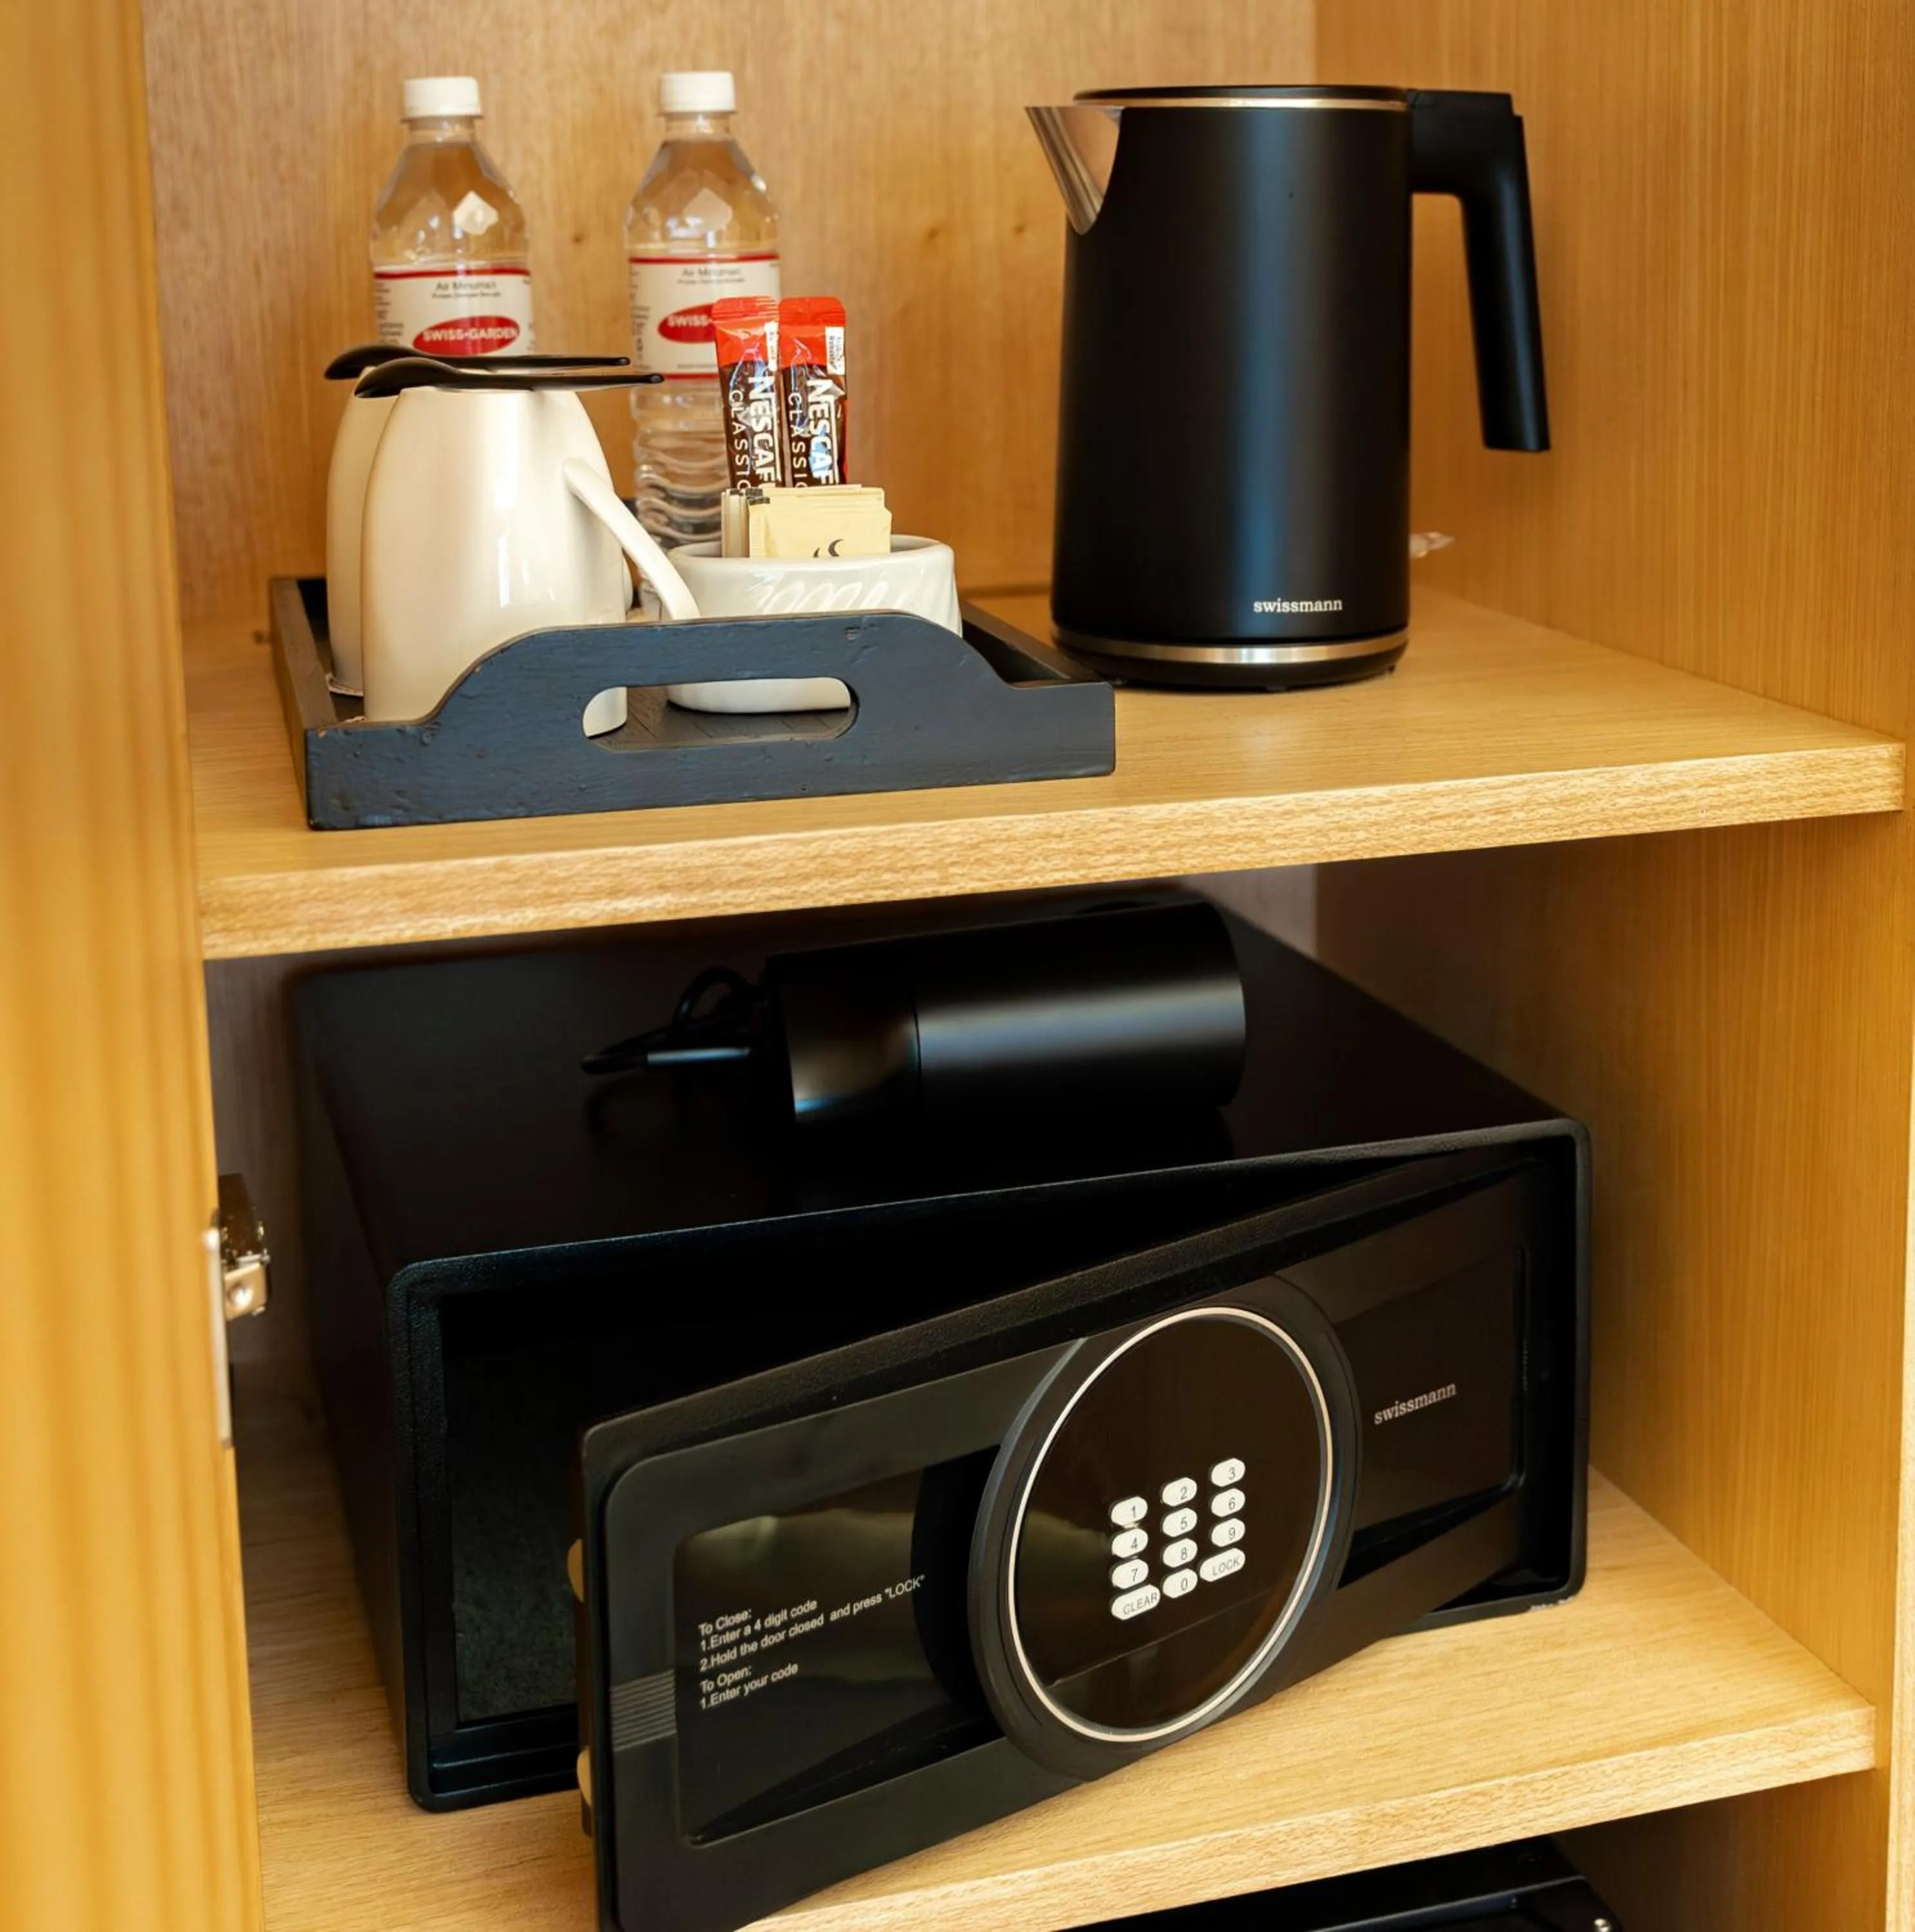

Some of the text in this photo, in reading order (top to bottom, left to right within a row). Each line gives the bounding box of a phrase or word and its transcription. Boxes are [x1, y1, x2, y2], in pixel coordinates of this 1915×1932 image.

[748, 375, 781, 482] NESCAF
[806, 379, 839, 484] NESCAF
[1253, 598, 1343, 612] swissmann
[1374, 1383, 1457, 1425] swissmann
[1180, 1486, 1187, 1501] 2
[1228, 1466, 1236, 1481] 3
[1131, 1497, 1236, 1549] 4 5 6
[1131, 1527, 1236, 1582] 7 8 9
[1123, 1559, 1240, 1615] CLEAR 0 LOCK
[699, 1608, 752, 1636] To Close:
[740, 1641, 759, 1656] the
[760, 1630, 786, 1648] door
[788, 1613, 824, 1637] closed
[829, 1603, 851, 1621] and
[853, 1593, 883, 1615] press
[884, 1574, 925, 1598] "LOCK"
[743, 1625, 751, 1636] a
[754, 1618, 761, 1631] 4
[764, 1609, 788, 1628] digit
[790, 1600, 818, 1618] code
[700, 1665, 752, 1694] To Open:
[743, 1675, 769, 1697] your
[771, 1663, 798, 1682] code
